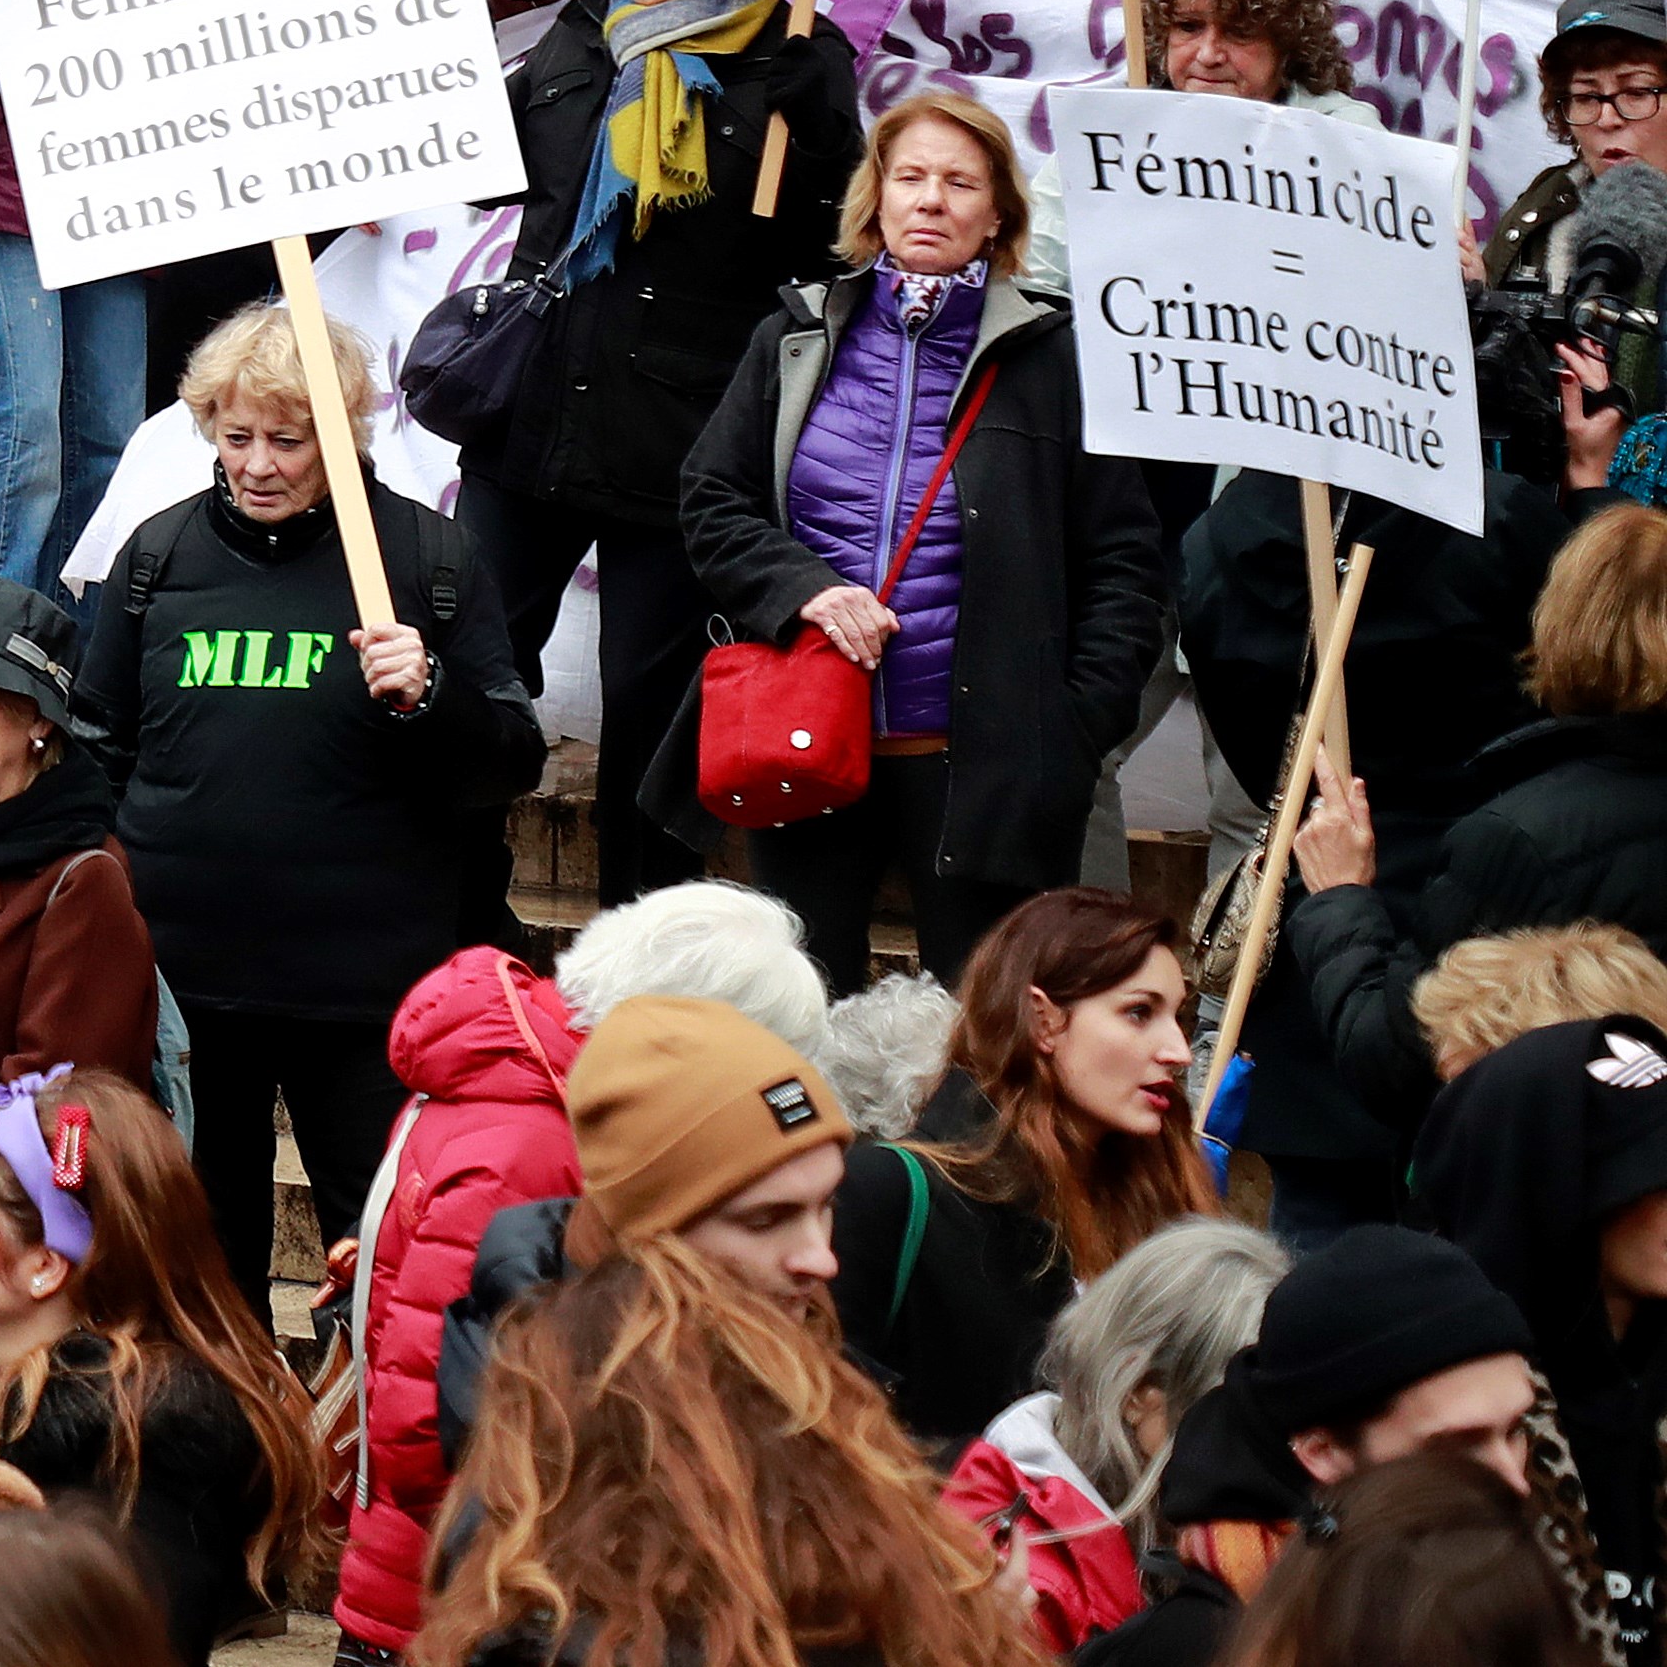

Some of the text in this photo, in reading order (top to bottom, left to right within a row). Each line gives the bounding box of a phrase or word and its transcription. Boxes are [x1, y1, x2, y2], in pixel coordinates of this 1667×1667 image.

[24, 46, 125, 108] 200
[142, 2, 381, 84] millions
[36, 54, 480, 179] femmes disparues
[65, 121, 485, 243] dans le monde
[1080, 131, 1439, 251] Féminicide
[1099, 275, 1459, 399] Crime contre
[1128, 350, 1447, 471] l'Humanité
[177, 629, 334, 690] MLF
